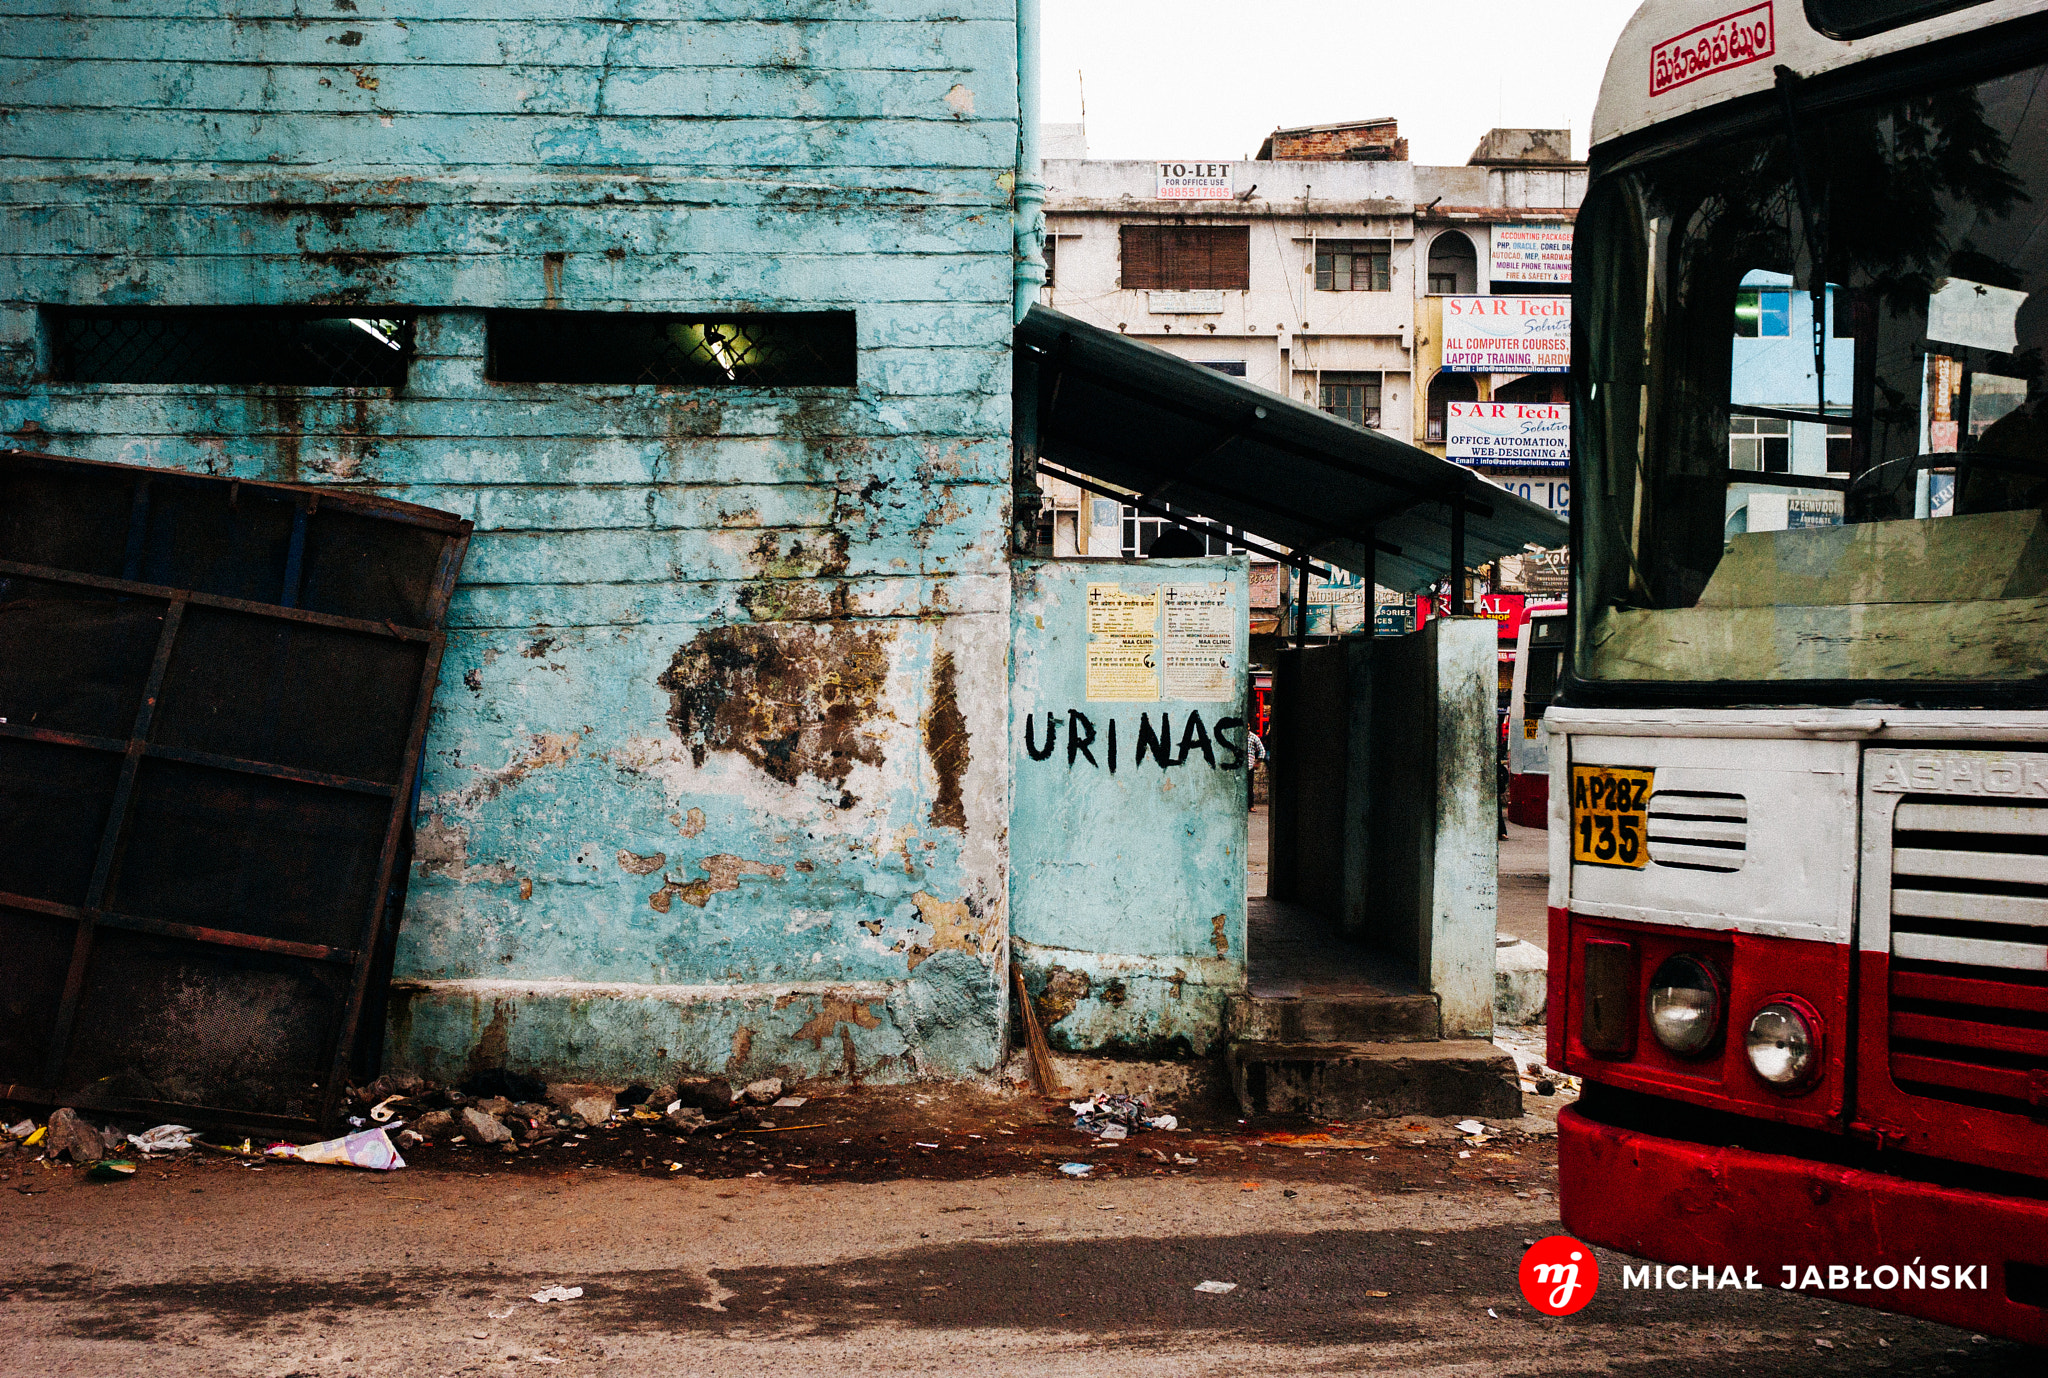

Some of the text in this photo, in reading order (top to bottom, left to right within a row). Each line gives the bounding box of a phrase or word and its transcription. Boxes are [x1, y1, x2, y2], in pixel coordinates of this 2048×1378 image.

[1161, 164, 1229, 177] TO-LET
[1161, 187, 1229, 197] 9885517685
[1501, 232, 1540, 240] ACCOUNTING
[1513, 242, 1539, 251] ORACLE,
[1541, 243, 1560, 251] COREL
[1517, 300, 1565, 316] Tech
[1446, 338, 1569, 352] ALL COMPUTER COURSES,
[1446, 353, 1483, 364] LAPTOP
[1487, 353, 1535, 365] TRAINING,
[1514, 405, 1560, 419] Tech
[1520, 421, 1570, 435] Solutio
[1451, 436, 1567, 448] OFFICE AUTOMATION,
[1471, 448, 1556, 458] WEB-DESIGNING
[1025, 709, 1243, 775] URINAS
[1575, 776, 1648, 812] AP28Z
[1580, 815, 1639, 863] 135
